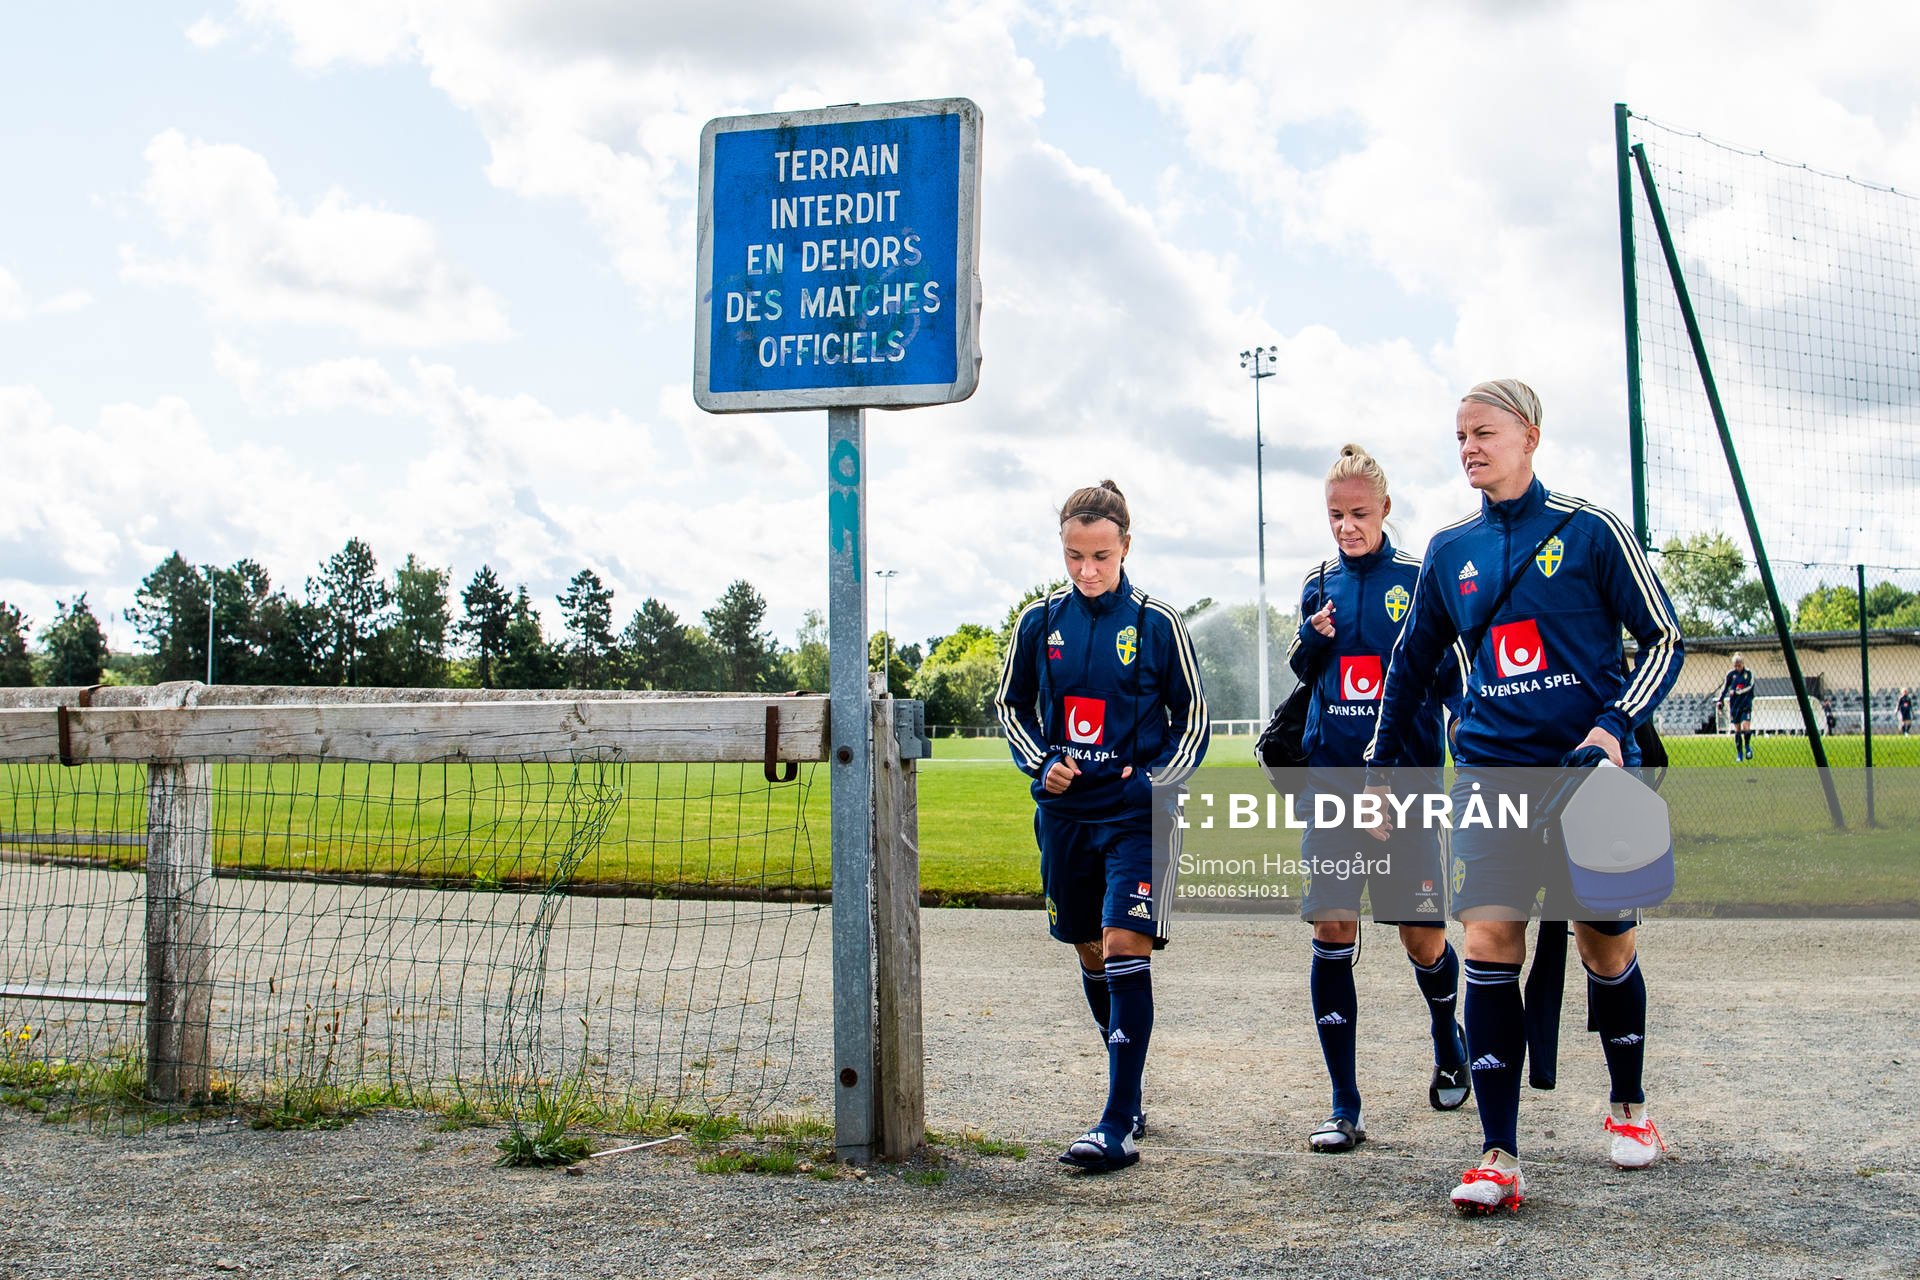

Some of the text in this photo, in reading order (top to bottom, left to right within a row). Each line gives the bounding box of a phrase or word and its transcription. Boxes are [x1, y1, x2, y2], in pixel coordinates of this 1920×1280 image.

[774, 143, 899, 183] TERRAIN
[771, 190, 901, 229] INTERDIT
[747, 234, 922, 276] EN DEHORS
[726, 280, 941, 323] DES MATCHES
[758, 330, 906, 368] OFFICIELS
[1048, 647, 1063, 660] CA
[1480, 673, 1581, 698] SVENSKA SPEL
[1093, 750, 1119, 763] SPL
